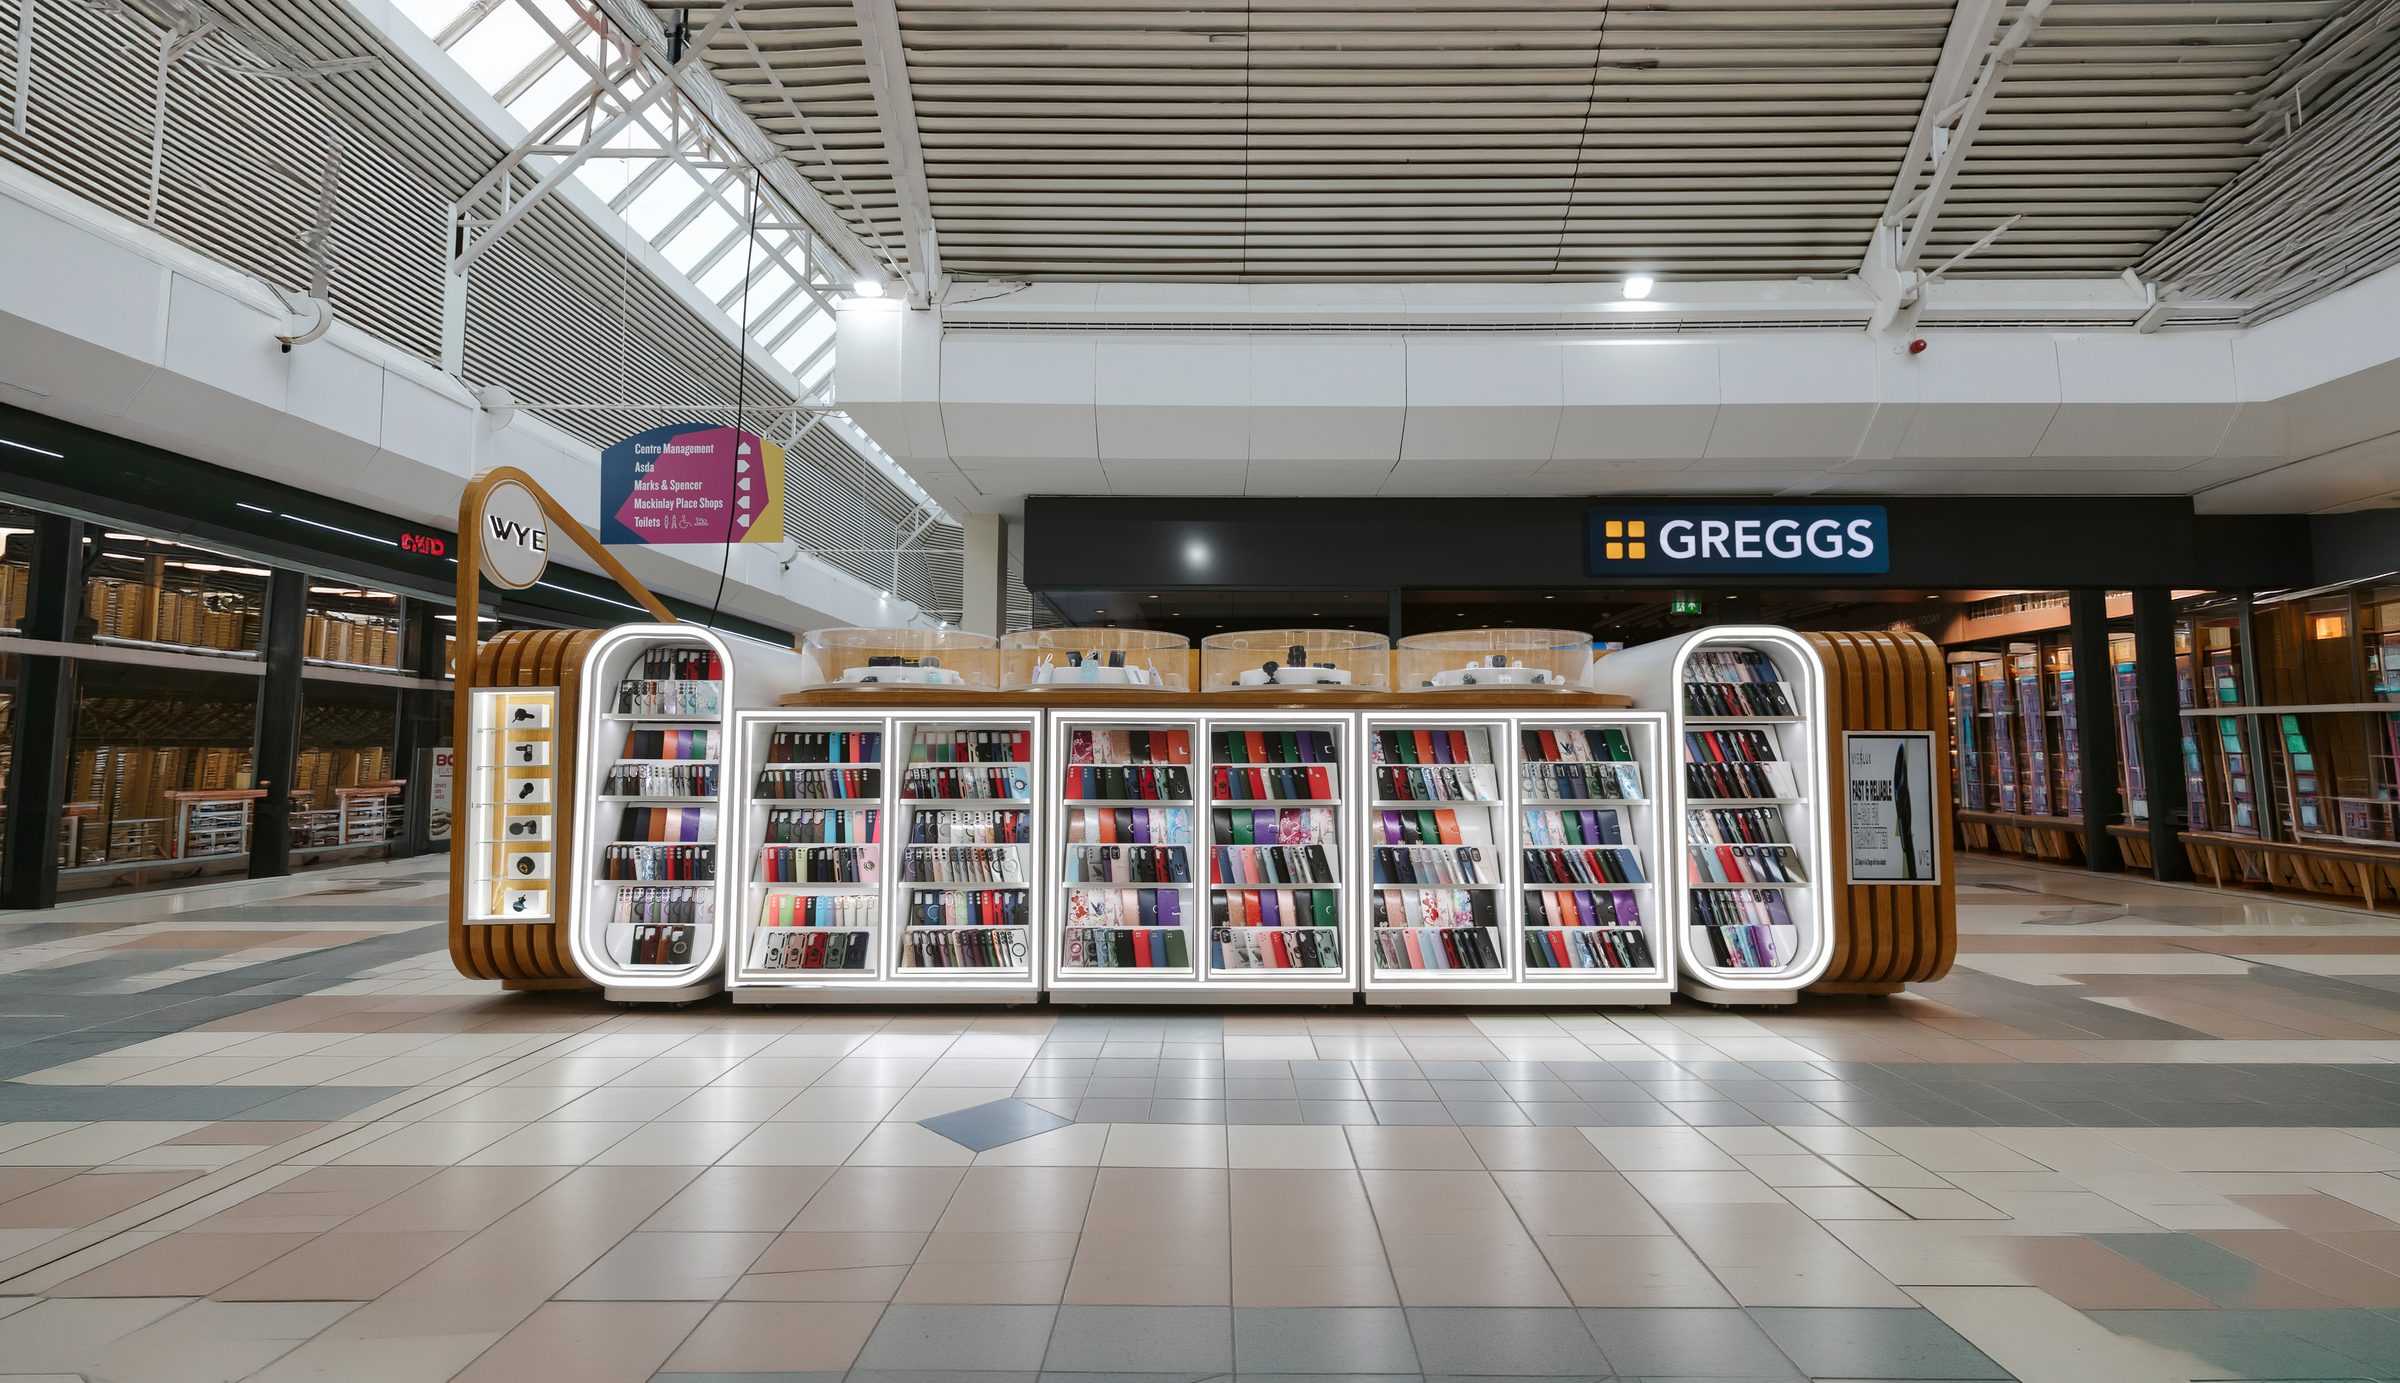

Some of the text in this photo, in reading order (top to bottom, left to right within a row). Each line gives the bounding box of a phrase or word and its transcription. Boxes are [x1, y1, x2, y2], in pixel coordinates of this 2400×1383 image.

[634, 443, 714, 456] Centre Management
[634, 461, 655, 473] Asda
[634, 479, 703, 492] Marks & Spencer
[634, 497, 723, 511] Mackinlay Place Shops
[634, 516, 661, 527] Toilets
[489, 515, 546, 552] WYE
[1659, 519, 1874, 559] GREGGS
[1852, 779, 1864, 801] FAST
[1870, 779, 1892, 801] RELIABLE
